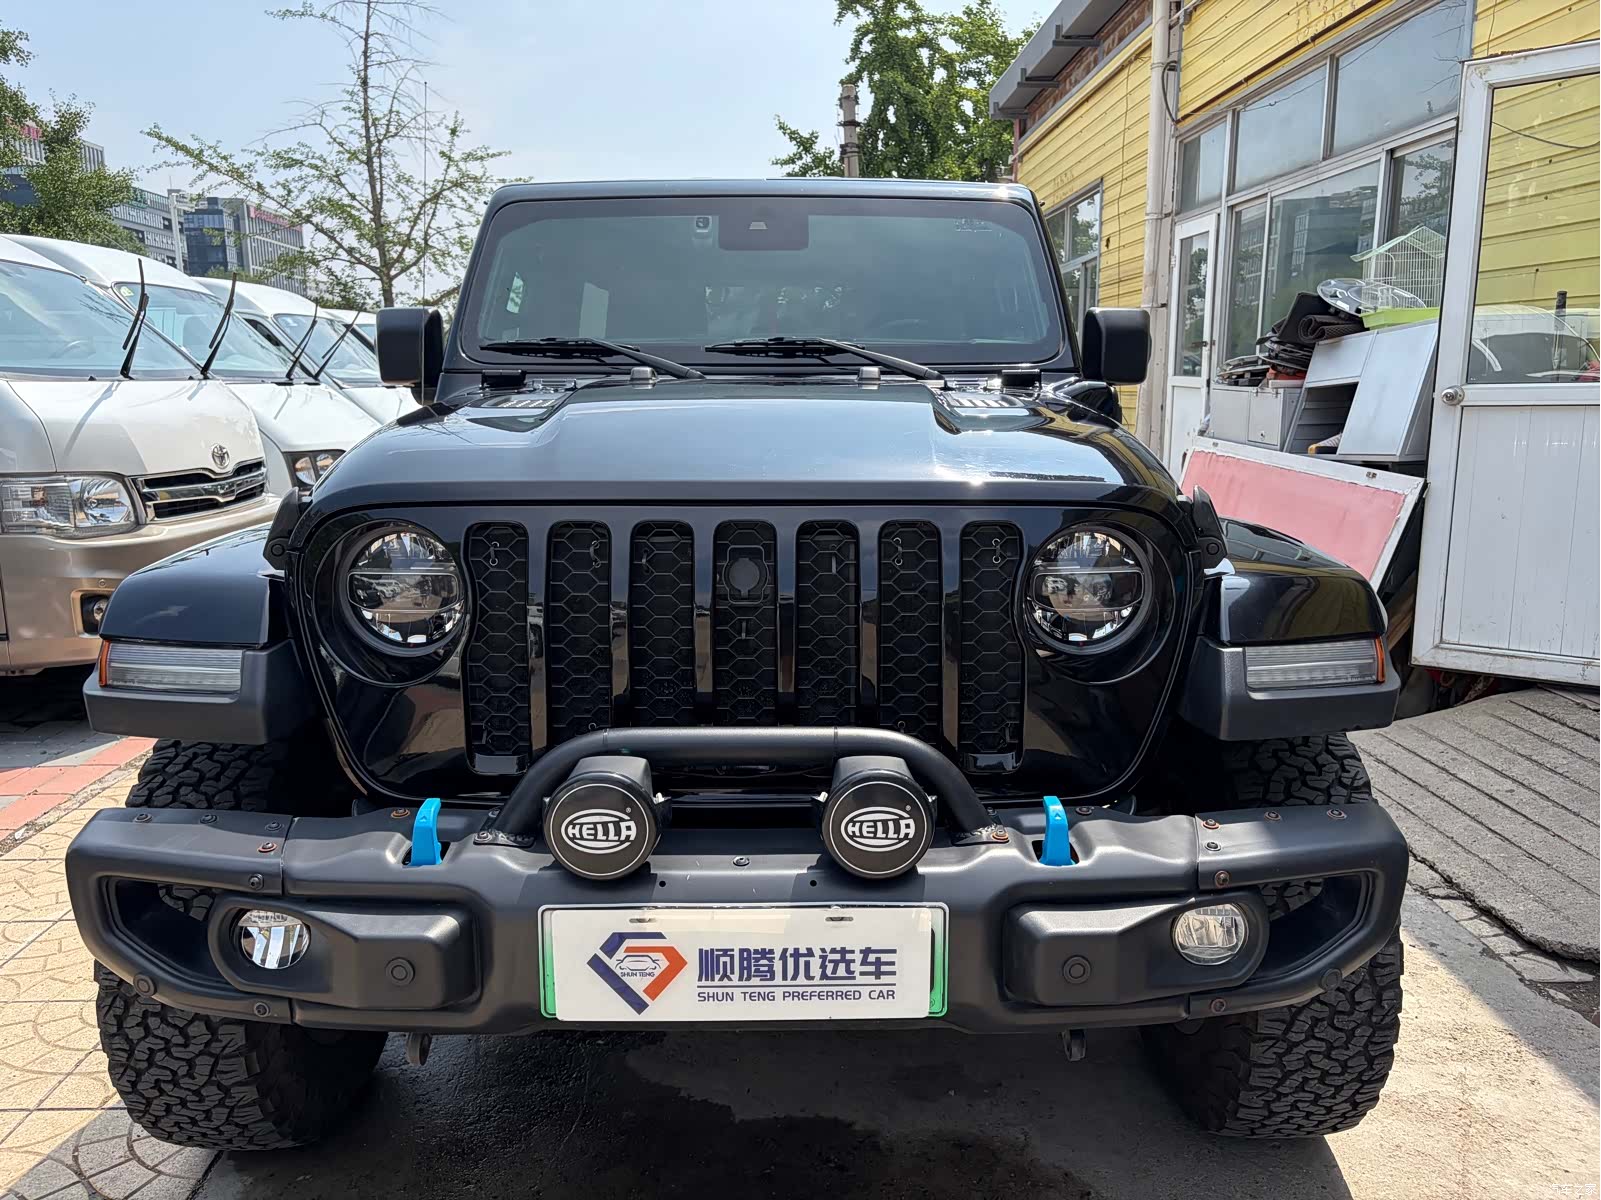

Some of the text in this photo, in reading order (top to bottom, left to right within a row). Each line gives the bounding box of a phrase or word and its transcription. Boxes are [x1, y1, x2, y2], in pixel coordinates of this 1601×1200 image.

[567, 820, 637, 841] HELLA
[847, 818, 916, 839] HELLA
[697, 946, 897, 982] 顺腾优选车
[697, 989, 896, 1002] SHUN TENG PREFERRED CAR
